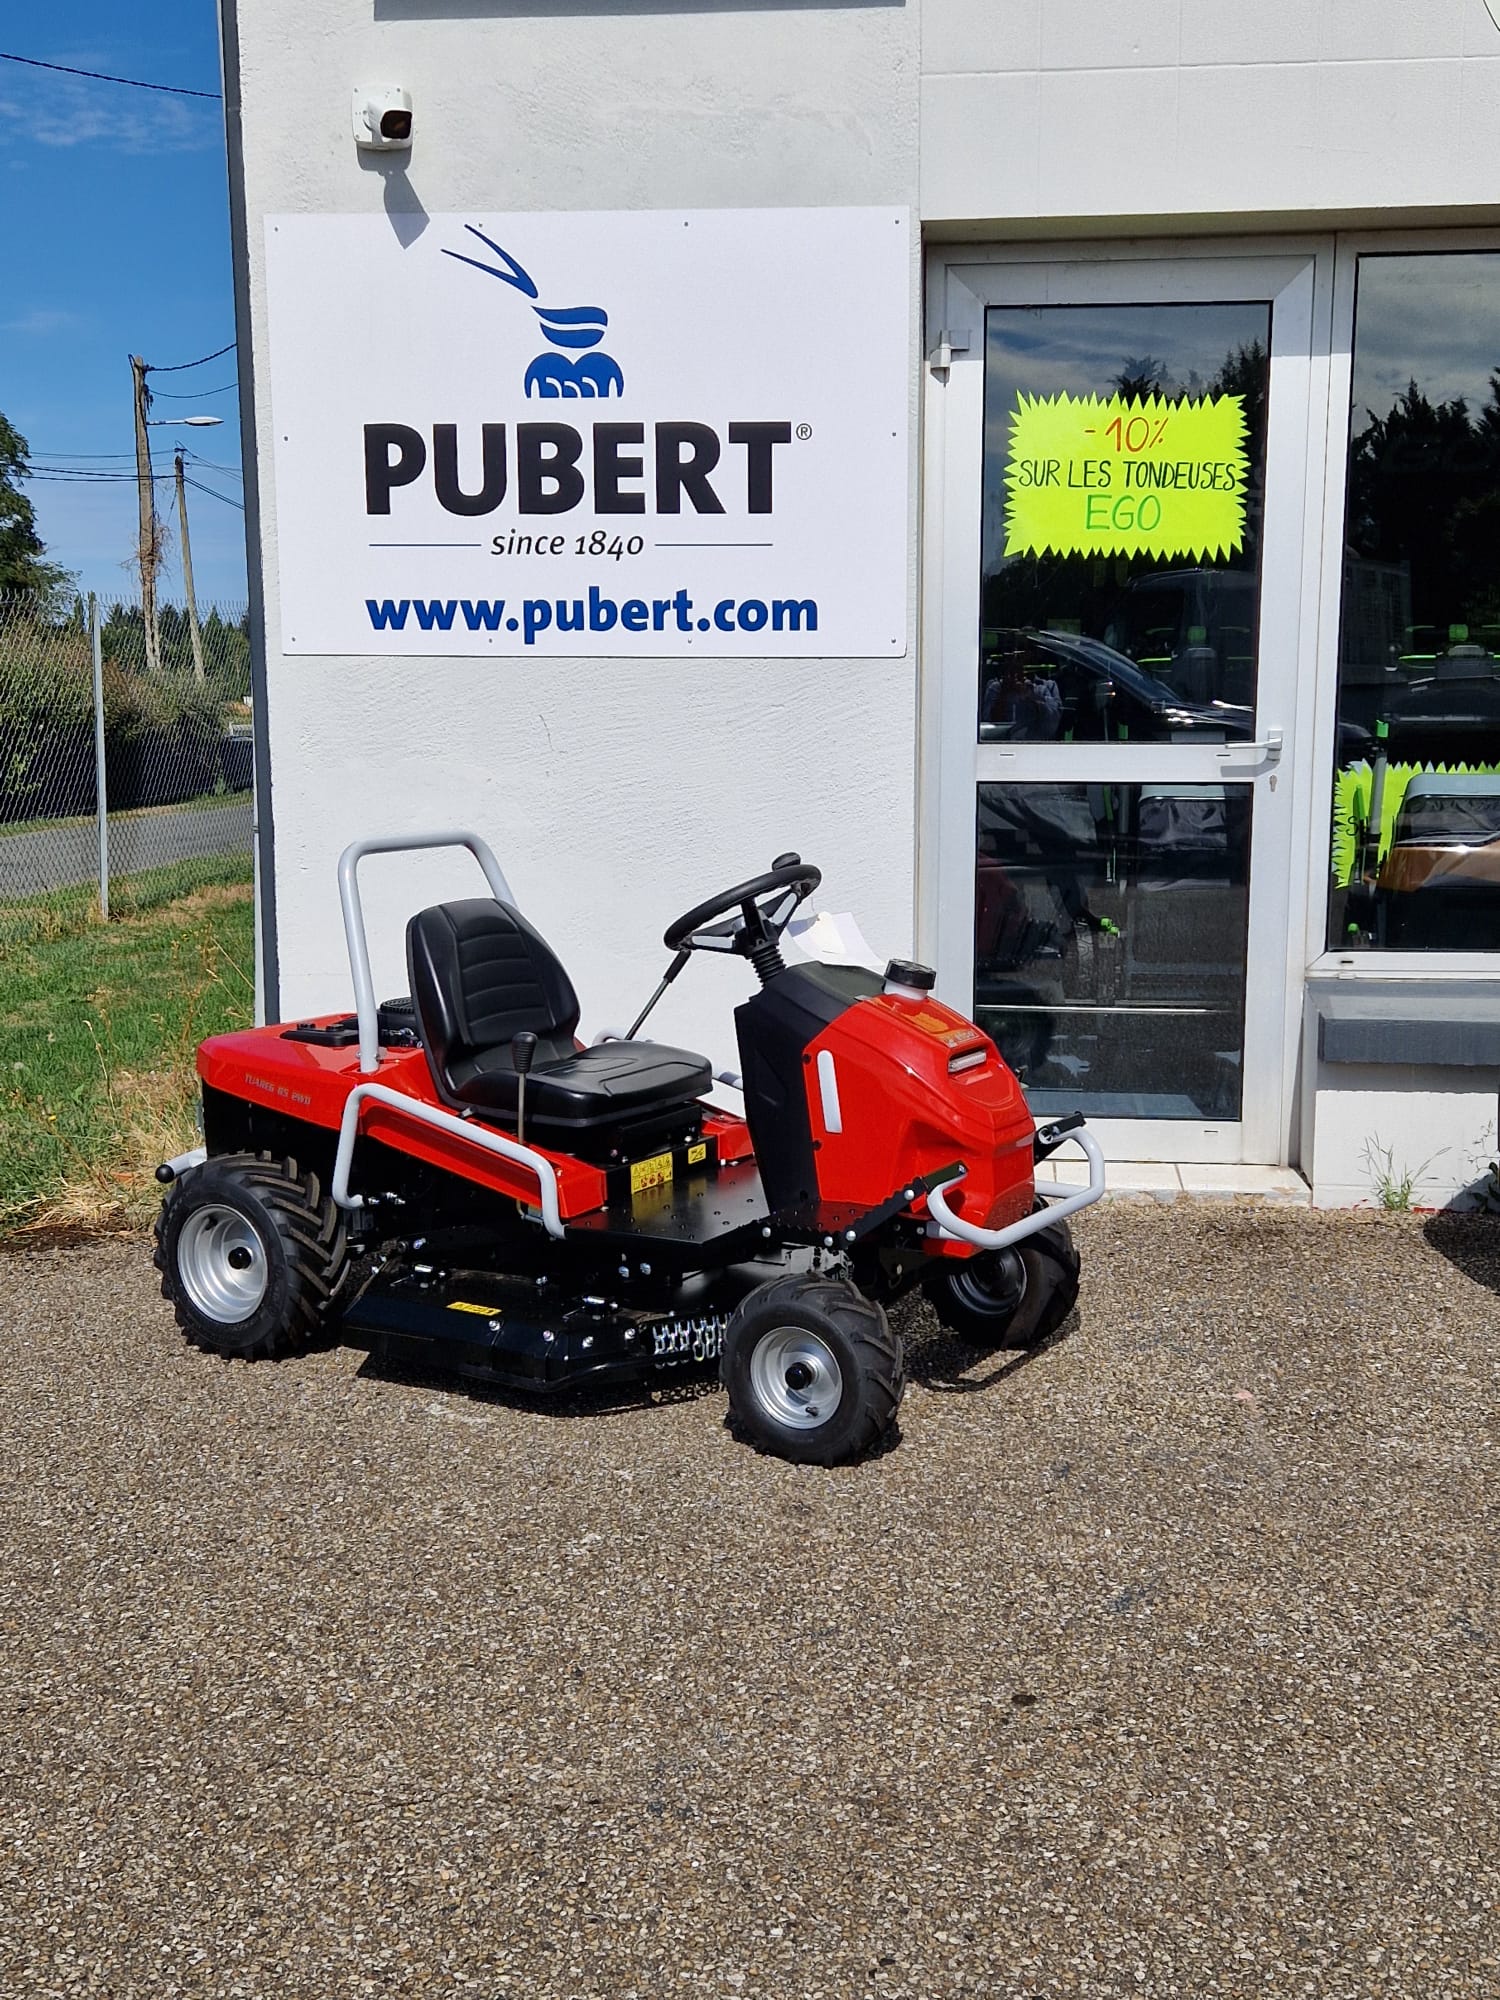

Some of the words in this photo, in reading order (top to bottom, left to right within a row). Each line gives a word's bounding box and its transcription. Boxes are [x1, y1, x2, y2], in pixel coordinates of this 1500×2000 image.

[1019, 459, 1061, 487] SUR
[1068, 460, 1111, 488] LES
[1123, 461, 1237, 491] TONDEUSES
[1086, 494, 1162, 531] EGO
[491, 528, 565, 556] since
[574, 530, 644, 562] 1840
[366, 585, 818, 644] www.pubert.com
